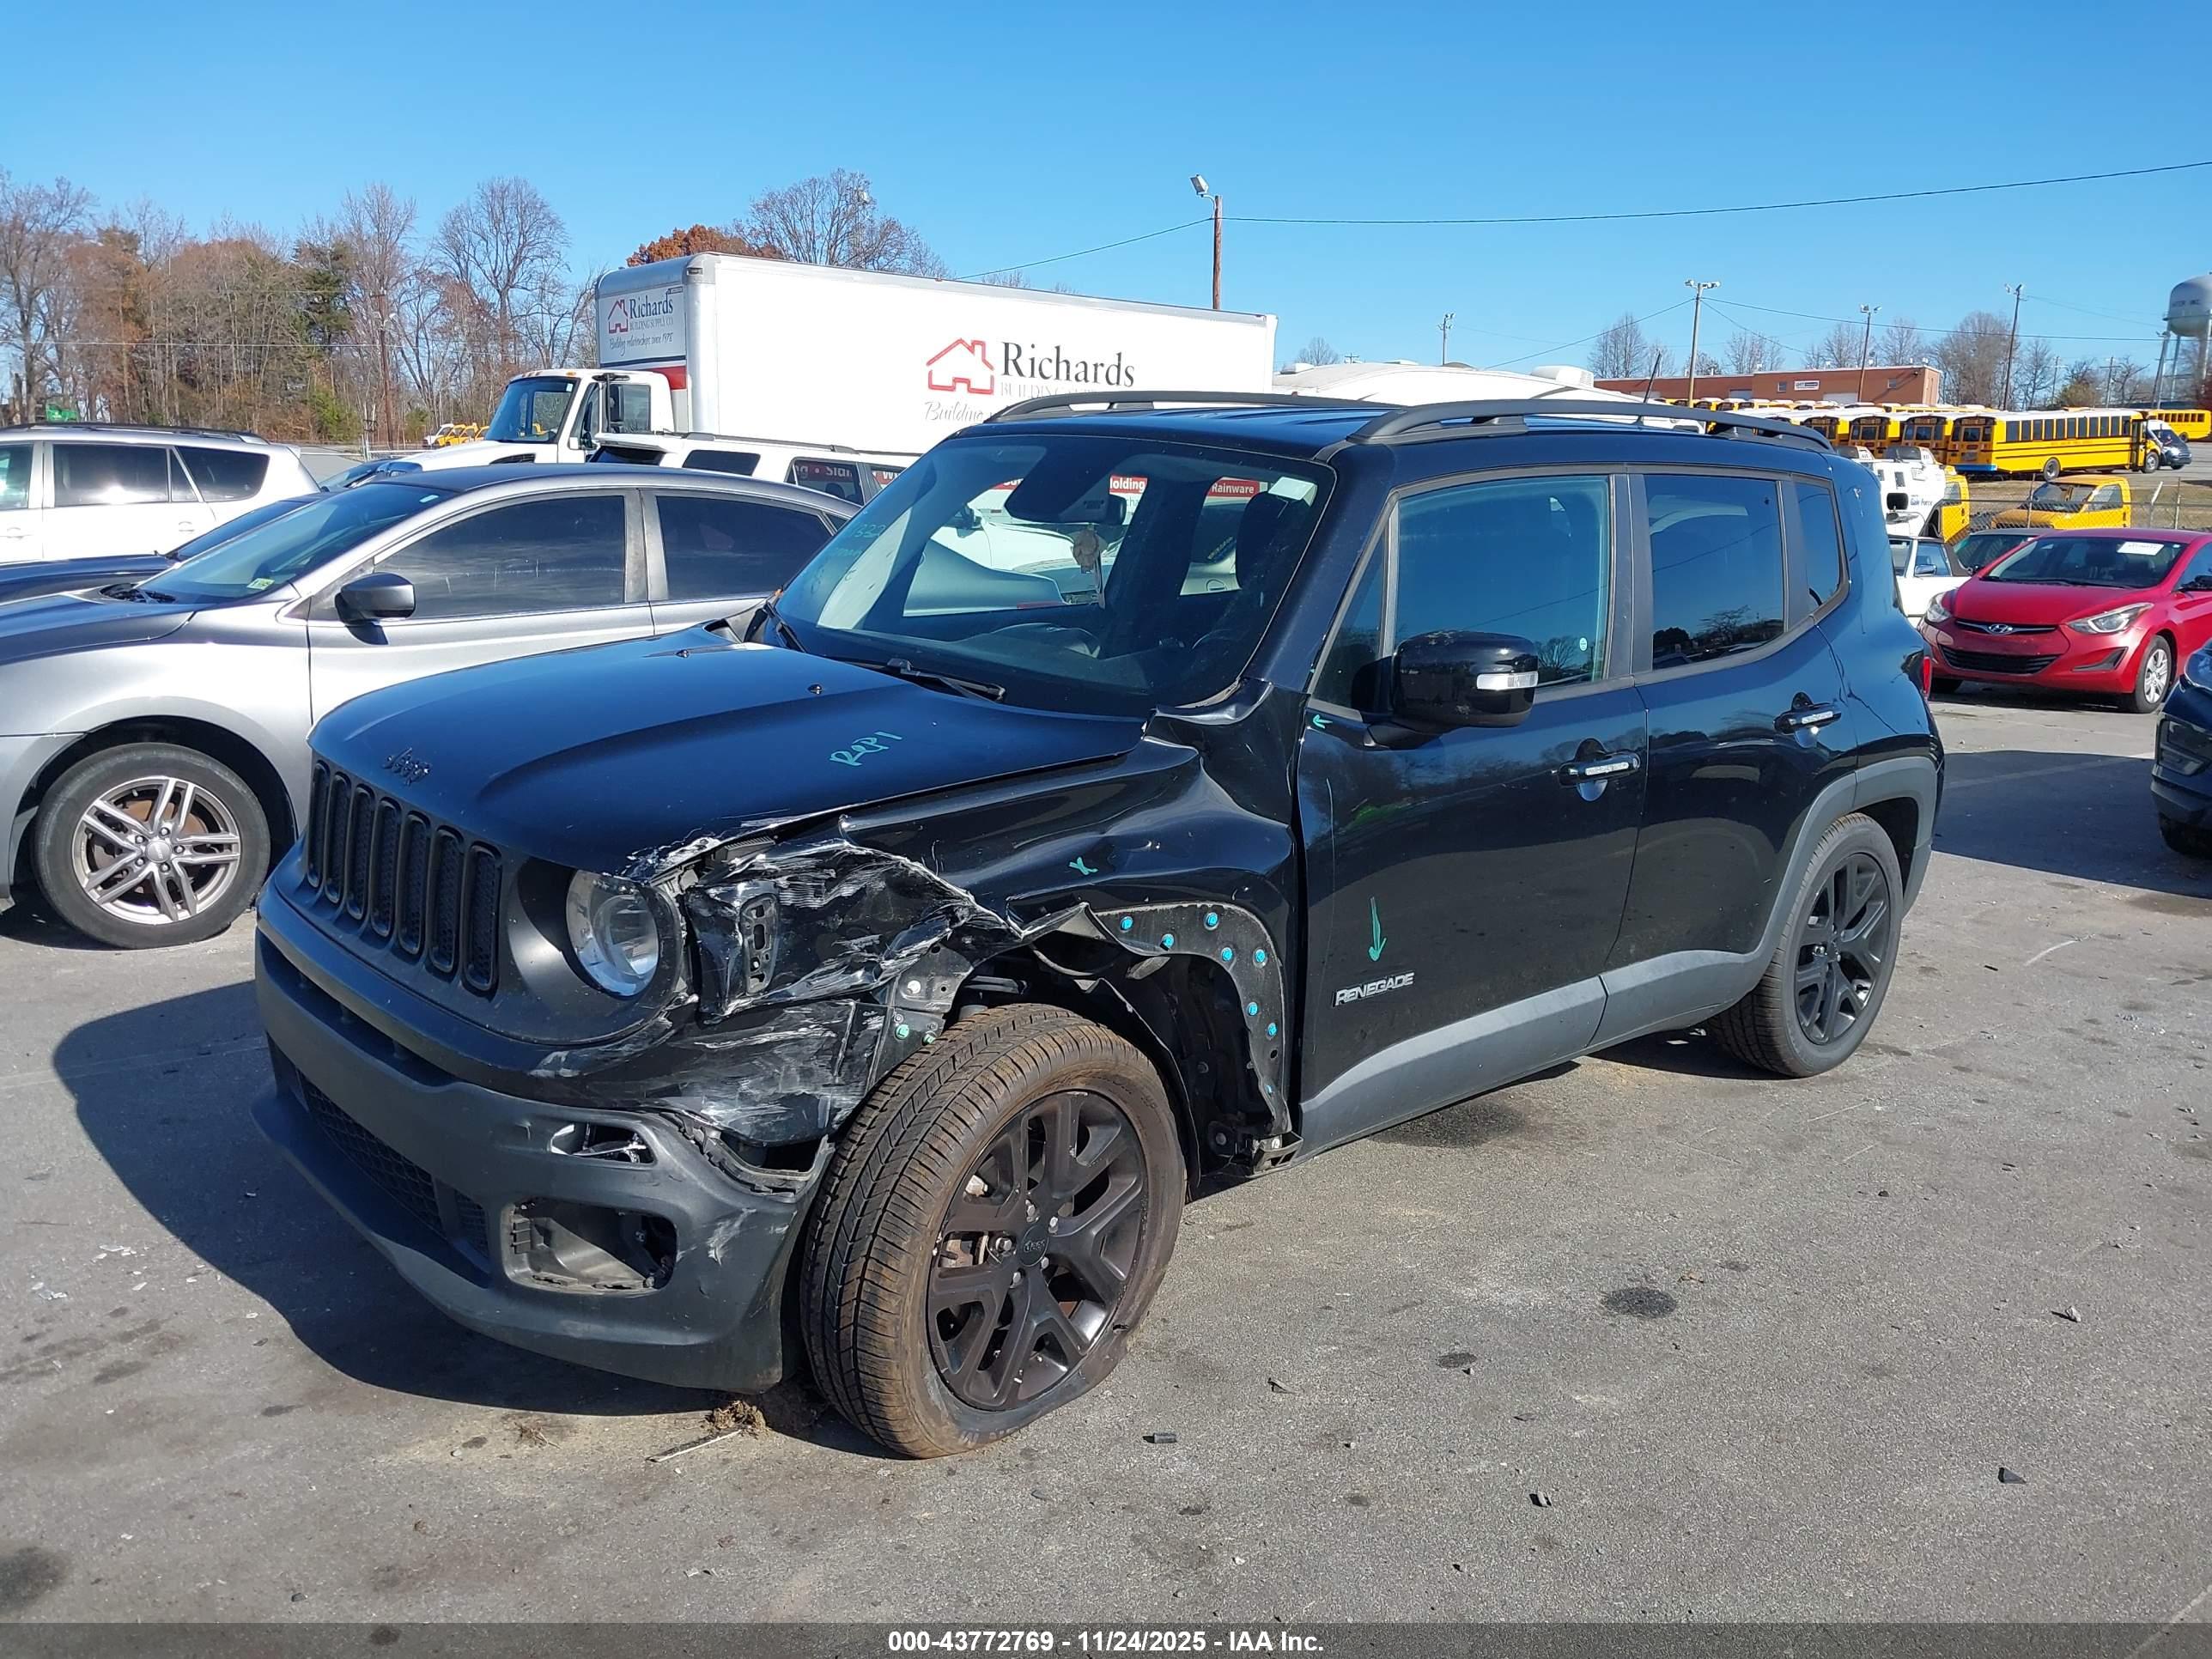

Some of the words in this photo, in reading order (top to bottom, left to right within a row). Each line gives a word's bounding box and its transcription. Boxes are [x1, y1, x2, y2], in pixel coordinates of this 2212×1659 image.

[629, 293, 674, 319] Richards
[1000, 342, 1134, 387] Richards
[1109, 477, 1146, 493] olding
[380, 747, 432, 787] Jeep
[1334, 972, 1414, 1006] RENEGADE
